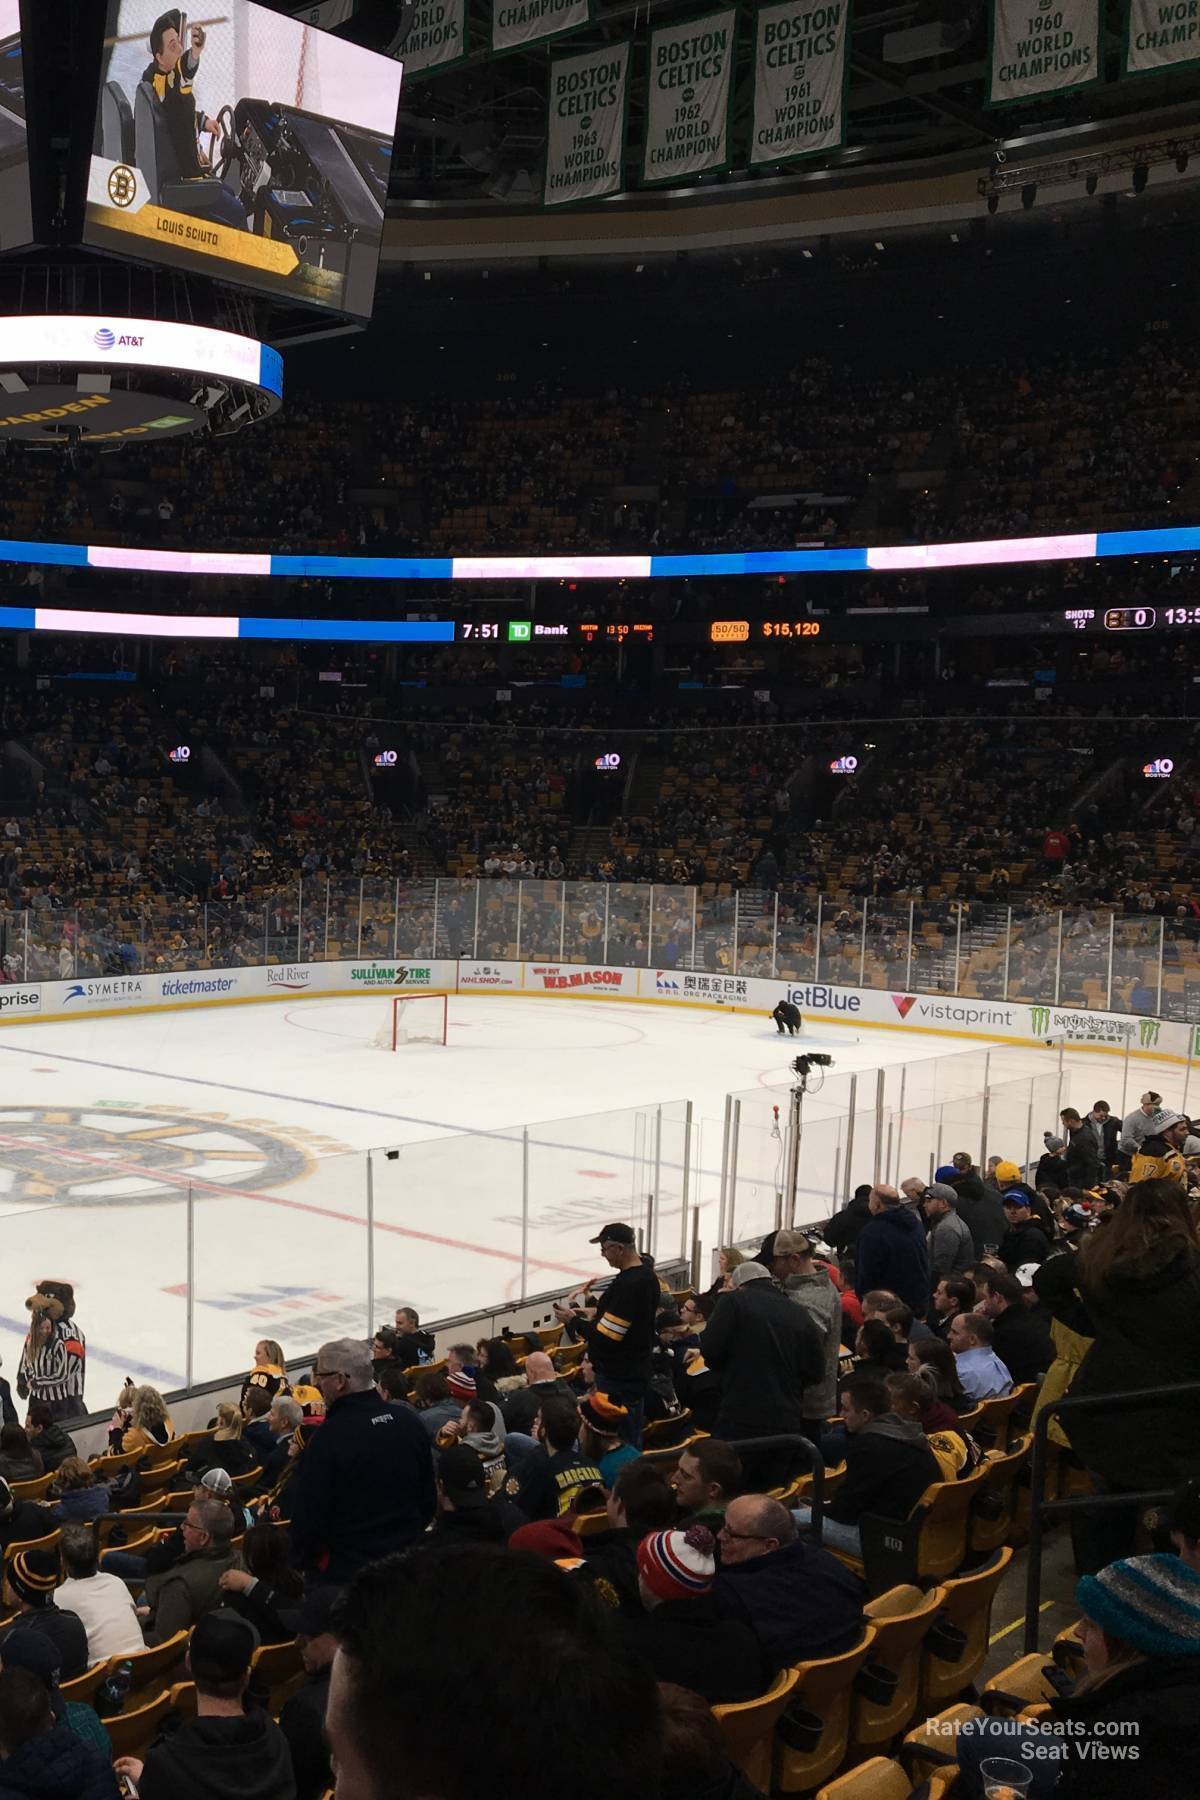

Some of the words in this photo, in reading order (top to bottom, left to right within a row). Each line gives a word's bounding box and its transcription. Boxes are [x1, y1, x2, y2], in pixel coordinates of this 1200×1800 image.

[412, 8, 446, 30] ORLD
[764, 5, 840, 45] BOSTON
[1028, 12, 1063, 36] 1960
[1017, 31, 1073, 59] WORLD
[1136, 22, 1200, 51] CHAMP
[656, 29, 728, 67] BOSTON
[766, 30, 836, 69] CELTICS
[658, 55, 722, 89] CELTICS
[999, 46, 1091, 82] CHAMPIONS
[556, 60, 621, 95] BOSTON
[558, 85, 617, 117] CELTICS
[785, 82, 811, 102] 1961
[675, 104, 700, 123] 1962
[775, 100, 822, 124] WORLD
[666, 120, 710, 143] WORLD
[758, 114, 835, 145] CHAMPIONS
[573, 131, 598, 149] 1963
[564, 147, 605, 168] WORLD
[550, 161, 617, 189] CHAMPIONS
[156, 216, 184, 236] LOUIS
[186, 227, 218, 246] SCIUTO
[118, 335, 144, 347] AT&T
[1065, 609, 1095, 620] SHOTS
[1073, 620, 1086, 629] 12
[1134, 610, 1147, 625] 0
[463, 624, 499, 638] 7:51
[511, 625, 528, 637] TD
[535, 624, 569, 636] Bank
[715, 624, 746, 634] 50/50
[763, 622, 820, 637] $15,120
[177, 745, 191, 758] 10
[383, 750, 398, 763] 10
[604, 753, 621, 766] 10
[840, 756, 858, 769] 10
[1155, 758, 1174, 773] 10
[267, 969, 284, 982] Red
[286, 967, 310, 981] River
[351, 963, 395, 980] SULLIVAN
[409, 967, 431, 979] TIRE
[88, 981, 142, 996] SYMETRA
[162, 977, 234, 996] ticketmaster
[786, 984, 861, 1011] jetBlue
[919, 1003, 1013, 1026] vistaprint
